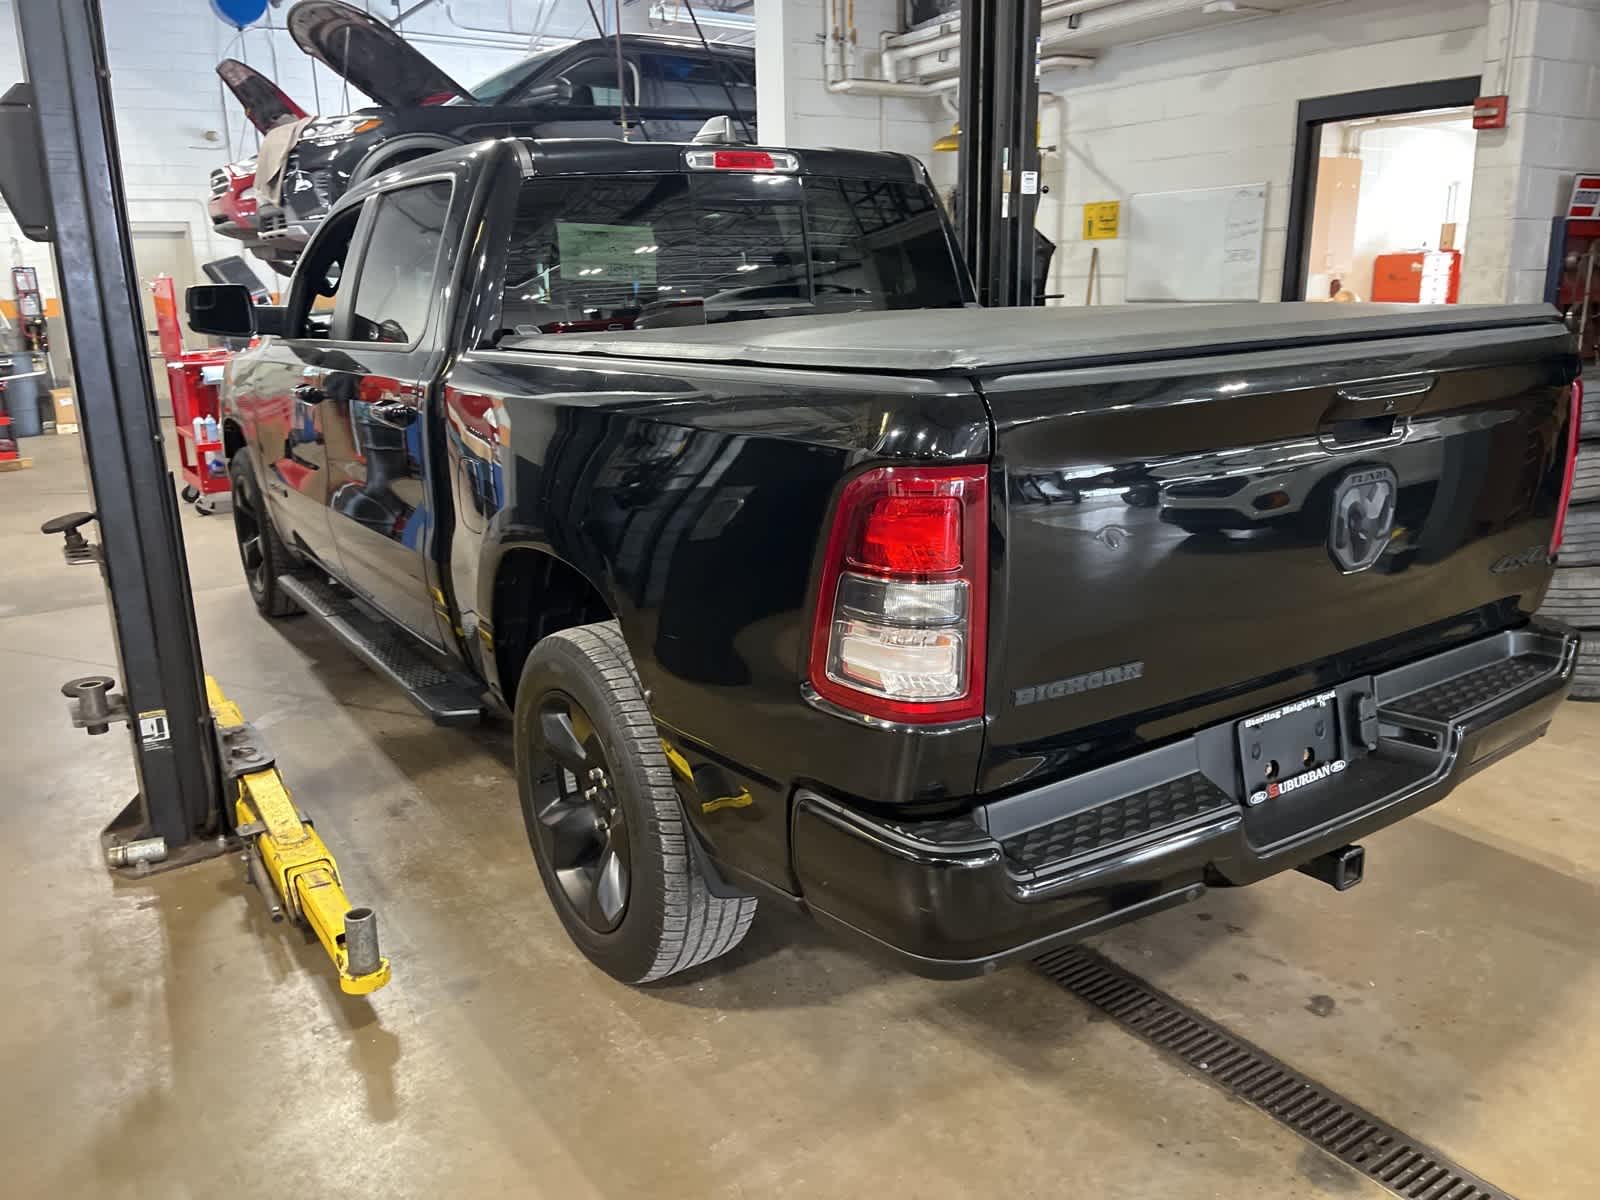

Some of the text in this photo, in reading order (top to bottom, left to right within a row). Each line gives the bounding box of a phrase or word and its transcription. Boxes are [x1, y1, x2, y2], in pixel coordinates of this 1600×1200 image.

[1351, 468, 1388, 483] RAM
[1245, 710, 1281, 728] Sterling
[1282, 698, 1316, 715] Heights
[1317, 690, 1336, 702] Ford
[1268, 765, 1331, 800] SUBURBAN
